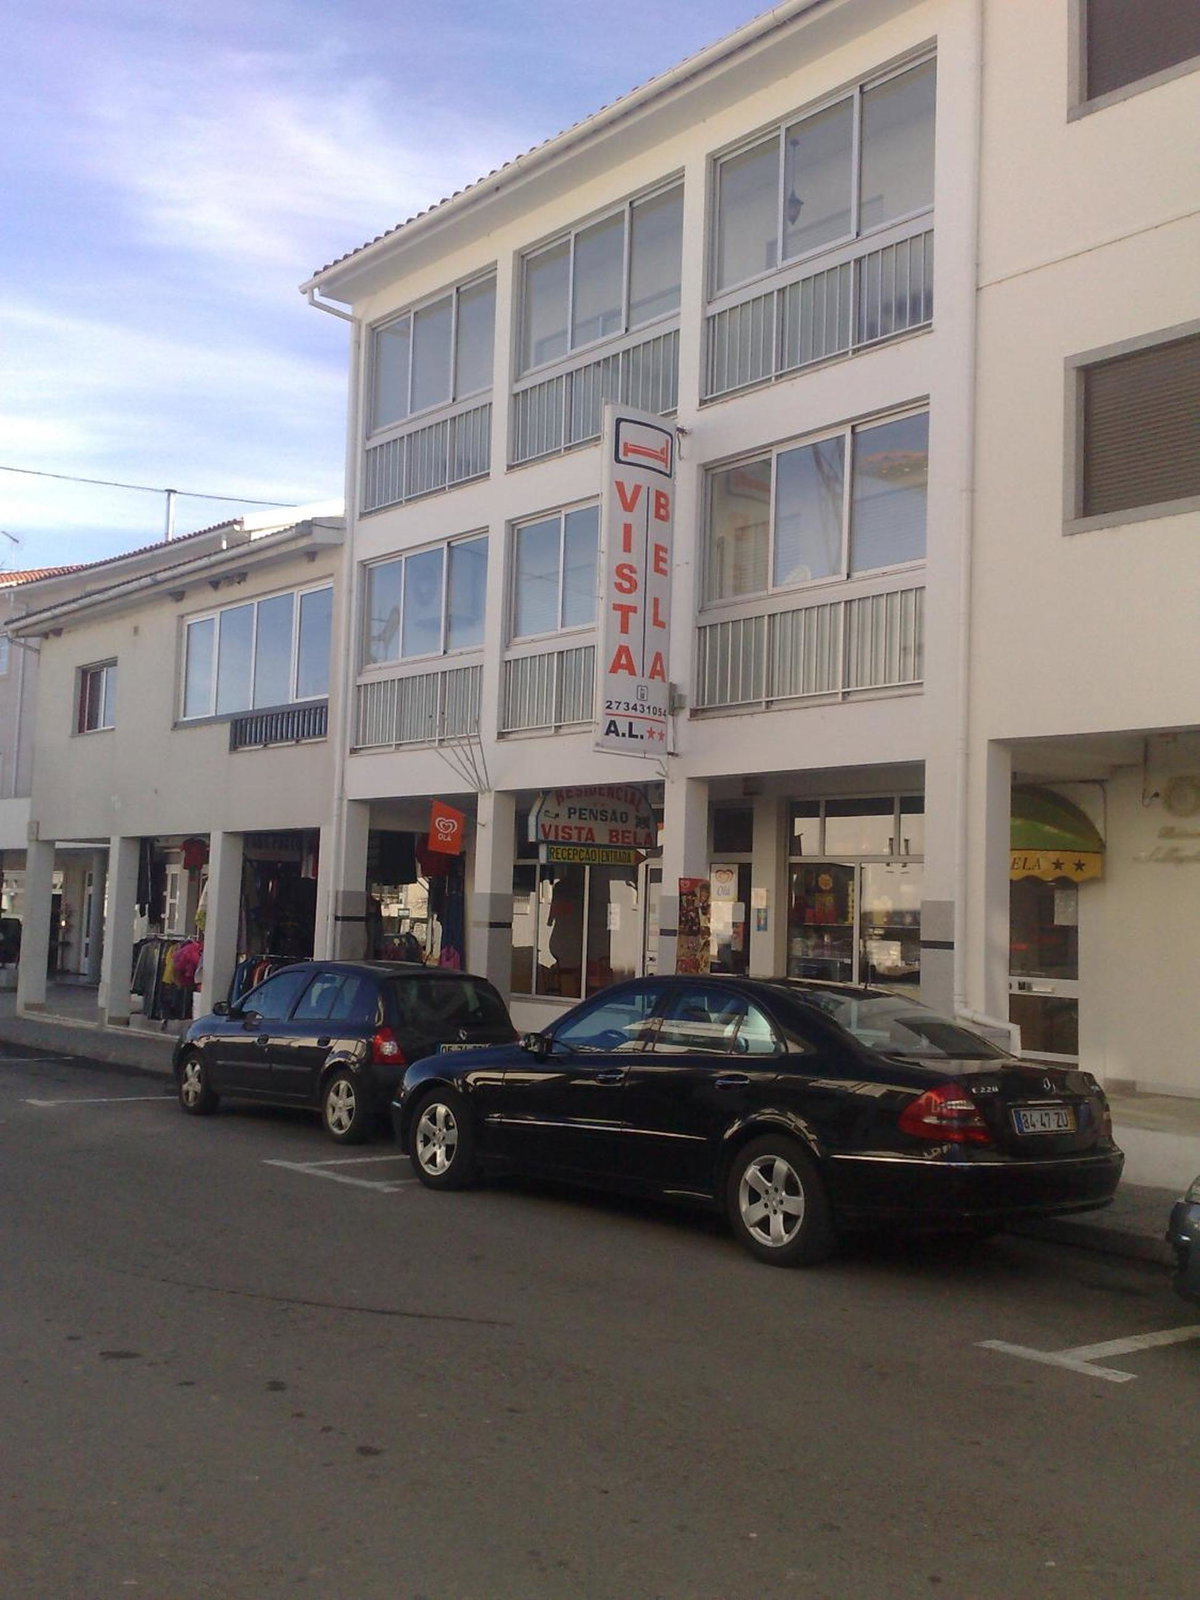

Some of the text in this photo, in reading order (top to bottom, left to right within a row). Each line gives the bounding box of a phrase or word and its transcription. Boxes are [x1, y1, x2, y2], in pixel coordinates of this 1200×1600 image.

[609, 480, 642, 677] VISTA
[649, 489, 670, 683] BELA
[604, 719, 644, 740] A.L.
[541, 823, 654, 847] VISTA BELA
